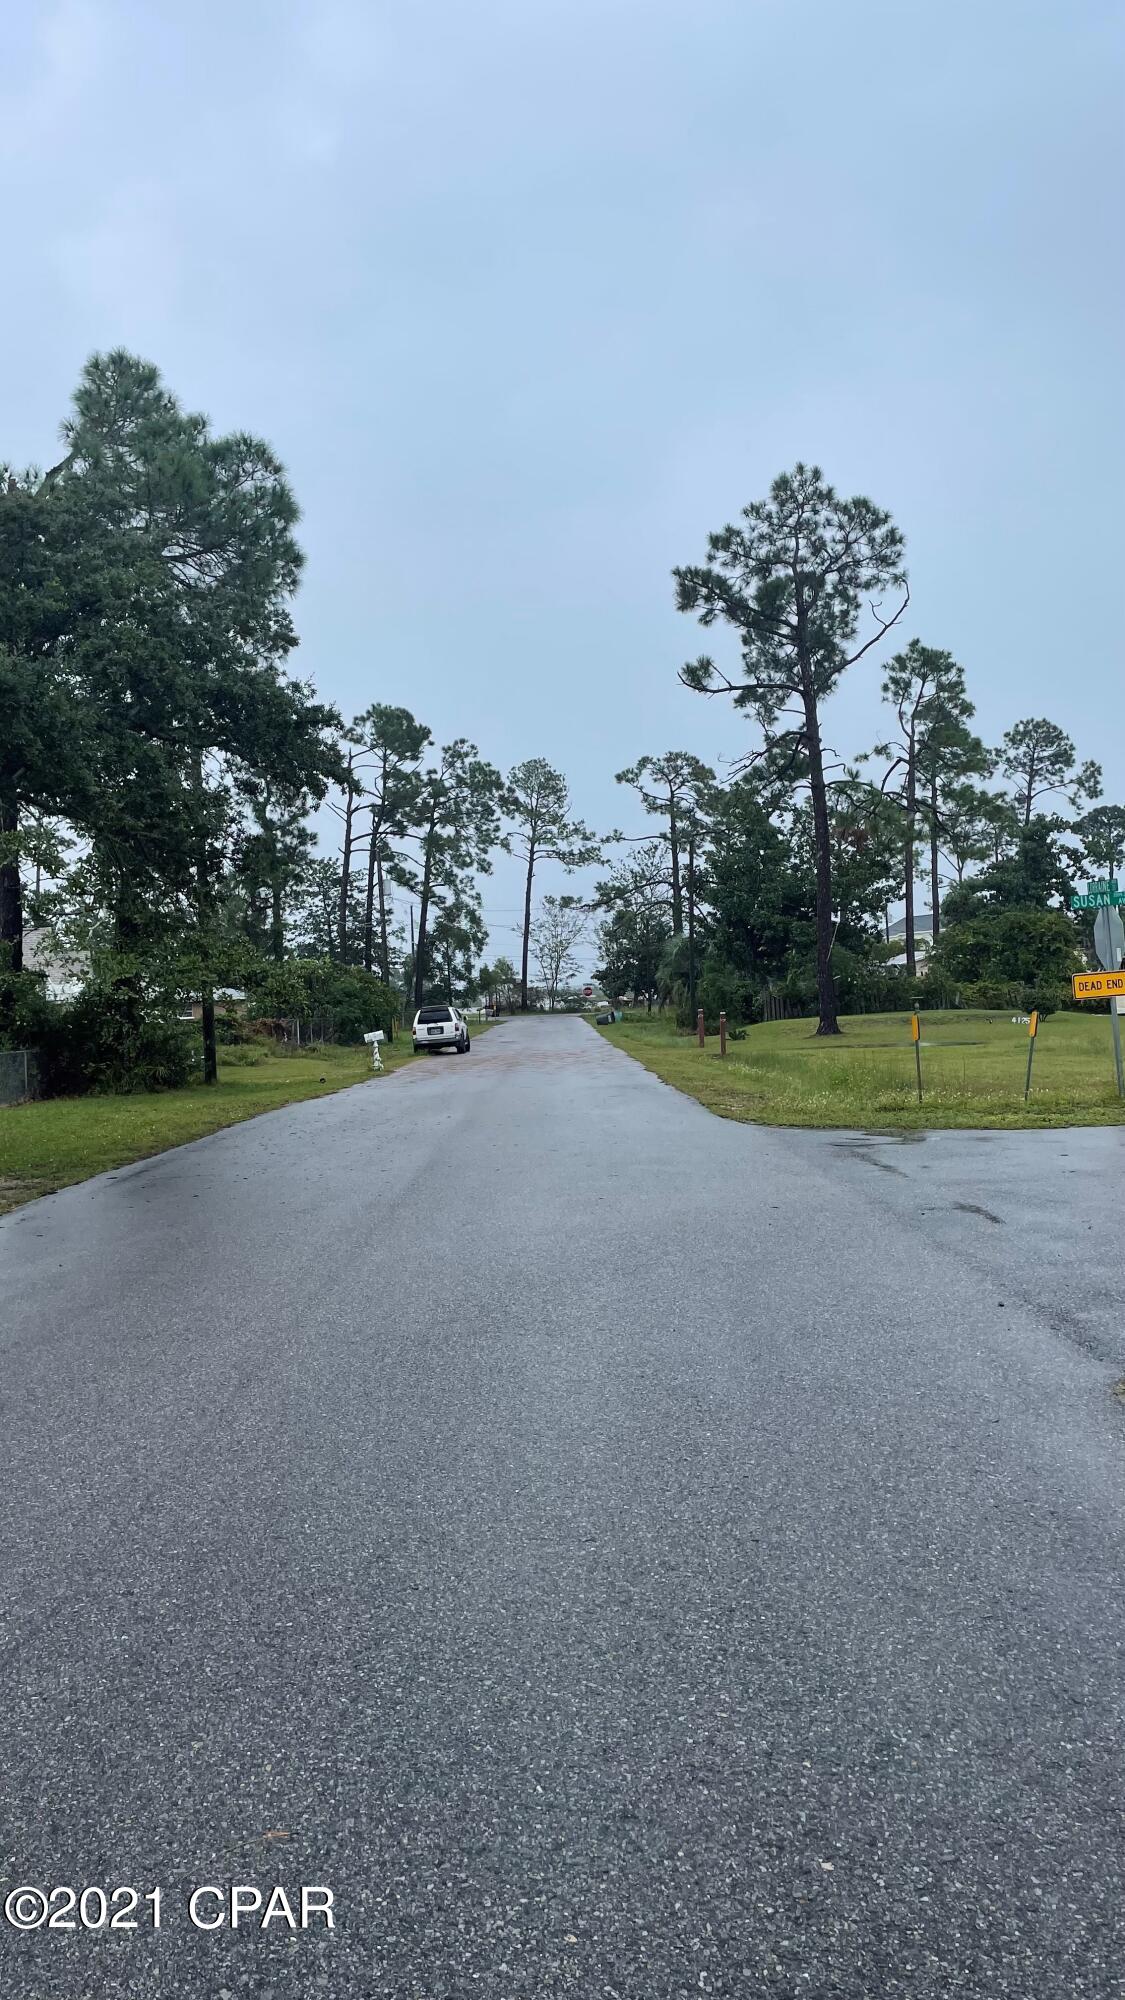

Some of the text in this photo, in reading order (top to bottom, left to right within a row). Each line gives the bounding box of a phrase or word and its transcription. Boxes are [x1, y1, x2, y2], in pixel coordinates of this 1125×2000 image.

[1073, 894, 1111, 908] SUSAN
[1078, 979, 1123, 992] DEAD END
